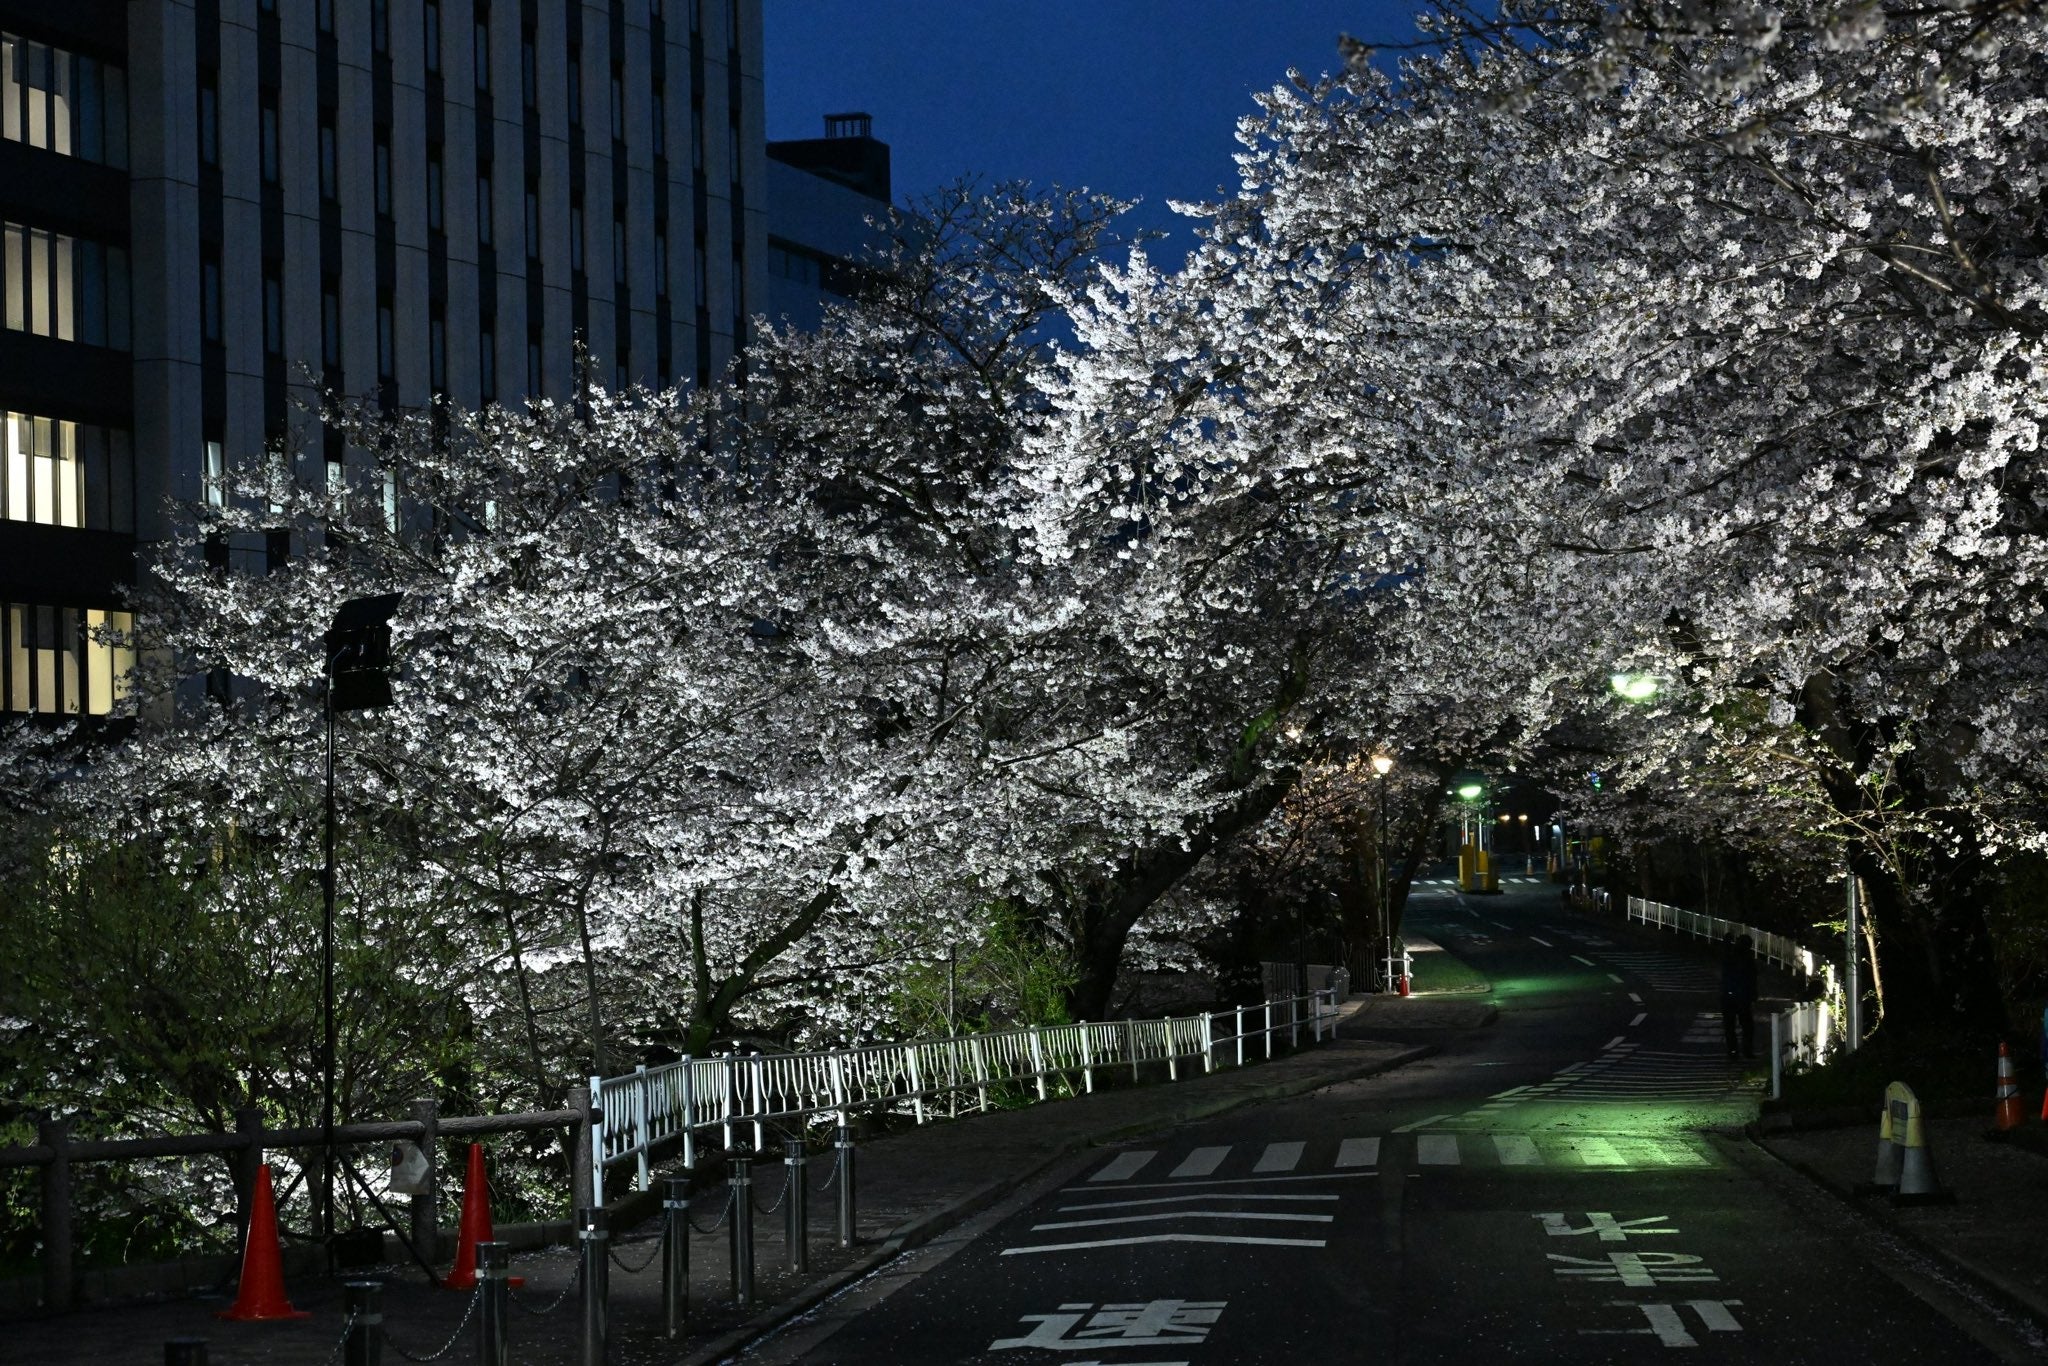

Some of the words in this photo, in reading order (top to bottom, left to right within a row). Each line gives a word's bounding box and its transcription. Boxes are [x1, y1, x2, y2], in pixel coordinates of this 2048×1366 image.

[1532, 1212, 1744, 1347] 止まれ
[987, 1299, 1228, 1366] 速
